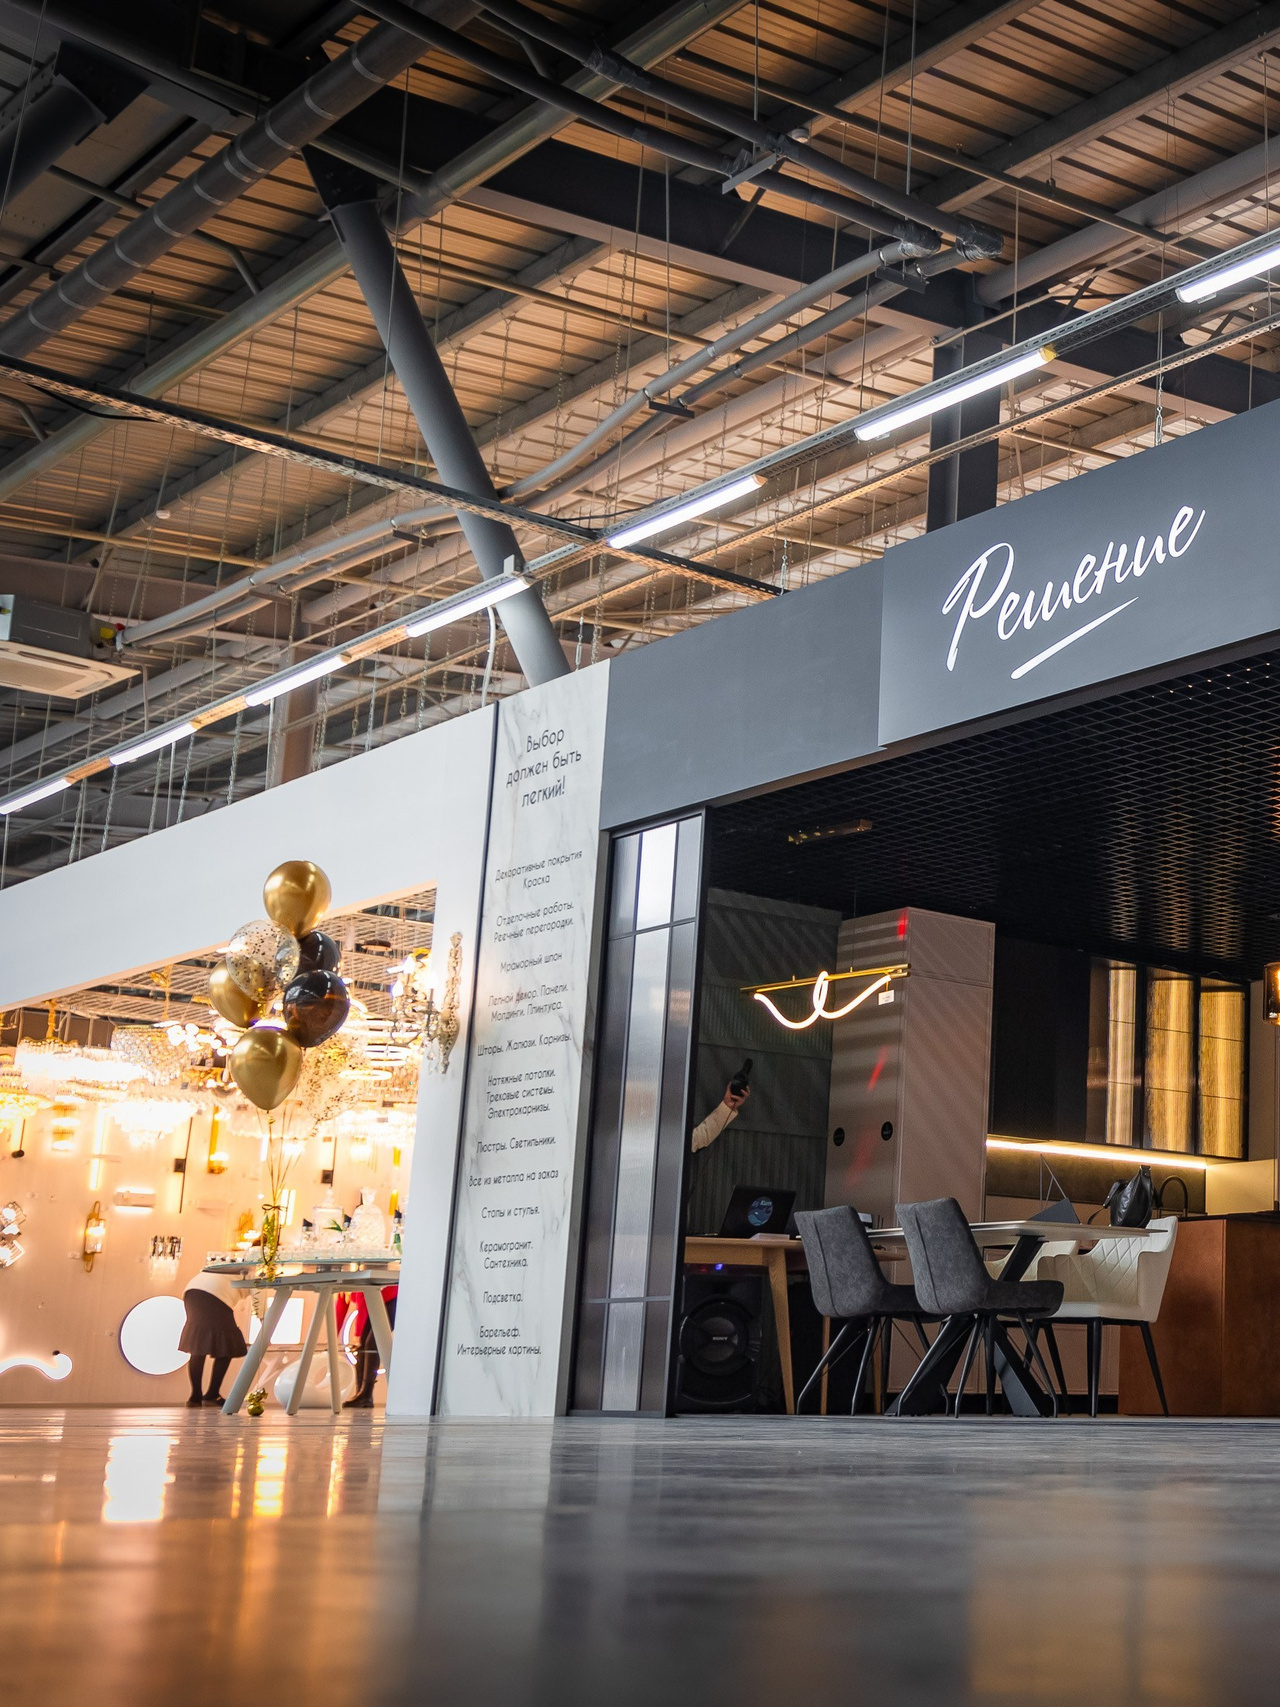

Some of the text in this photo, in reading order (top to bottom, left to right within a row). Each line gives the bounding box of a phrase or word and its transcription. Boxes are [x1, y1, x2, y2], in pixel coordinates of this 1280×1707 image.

[942, 505, 1205, 672] Решение
[527, 729, 564, 753] Выбор
[506, 751, 581, 788] должен быть
[522, 779, 565, 807] легкий!
[548, 851, 582, 866] покрытия
[523, 875, 550, 889] Краска
[543, 902, 574, 917] работы.
[526, 918, 573, 935] перегородки.
[500, 953, 562, 973] Мраморный шпон
[515, 990, 538, 1003] декор.
[541, 985, 568, 996] Панели.
[527, 1002, 563, 1014] Плинтуса.
[478, 1033, 572, 1056] Шторы. Жалюзи. Карнизы.
[488, 1069, 555, 1086] Натяжные потолки.
[522, 1086, 554, 1098] системы.
[488, 1104, 550, 1119] Электрокарнизы.
[476, 1137, 556, 1153] Люстры. Светильники.
[469, 1170, 558, 1187] Все из металла на заказ
[482, 1207, 505, 1218] Столы
[514, 1206, 540, 1217] стулья.
[480, 1241, 533, 1254] Керамогранит.
[484, 1257, 528, 1269] Сантехника.
[483, 1291, 523, 1305] Подсветка.
[457, 1344, 541, 1357] Интерьерные картины.
